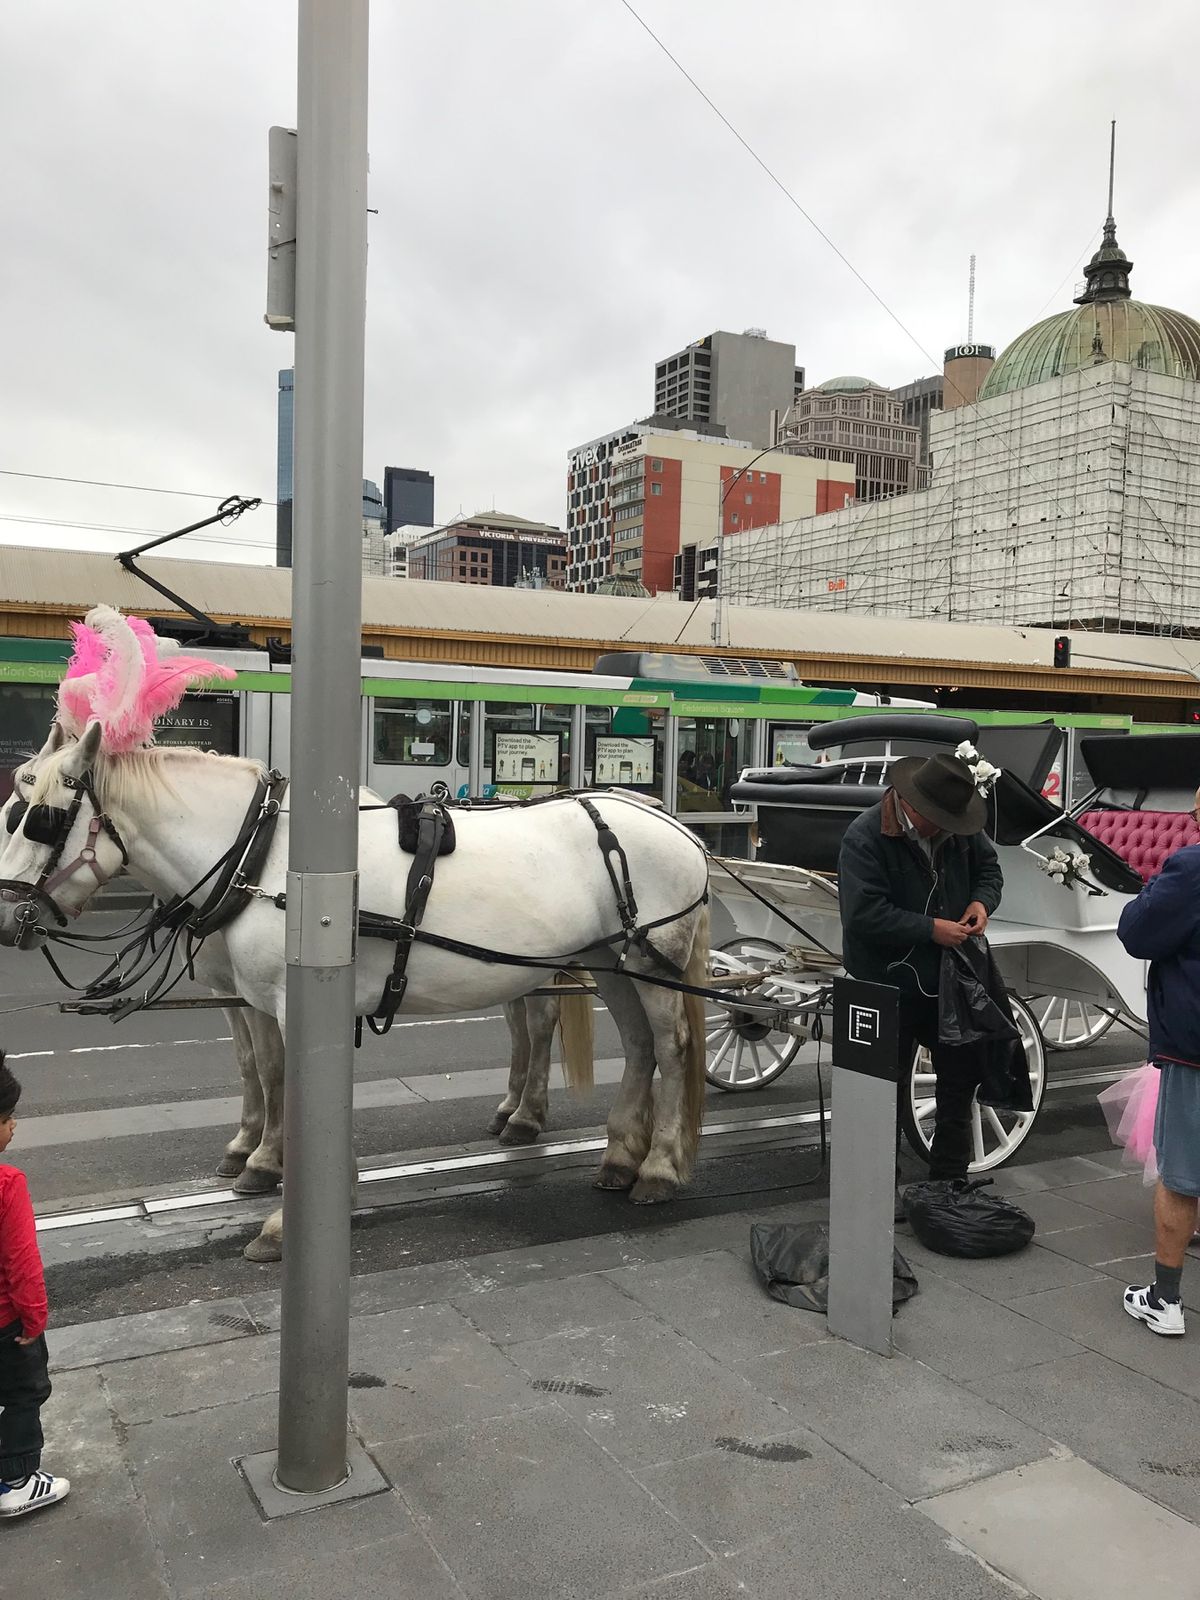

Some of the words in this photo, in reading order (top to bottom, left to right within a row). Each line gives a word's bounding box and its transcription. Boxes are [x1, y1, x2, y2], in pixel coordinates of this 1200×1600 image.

[954, 344, 982, 357] IOOF
[479, 530, 515, 540] VICTORIA
[519, 535, 562, 545] UNIVERSITY
[681, 703, 719, 713] Federation
[153, 718, 195, 726] DINARY
[855, 1010, 873, 1038] F
